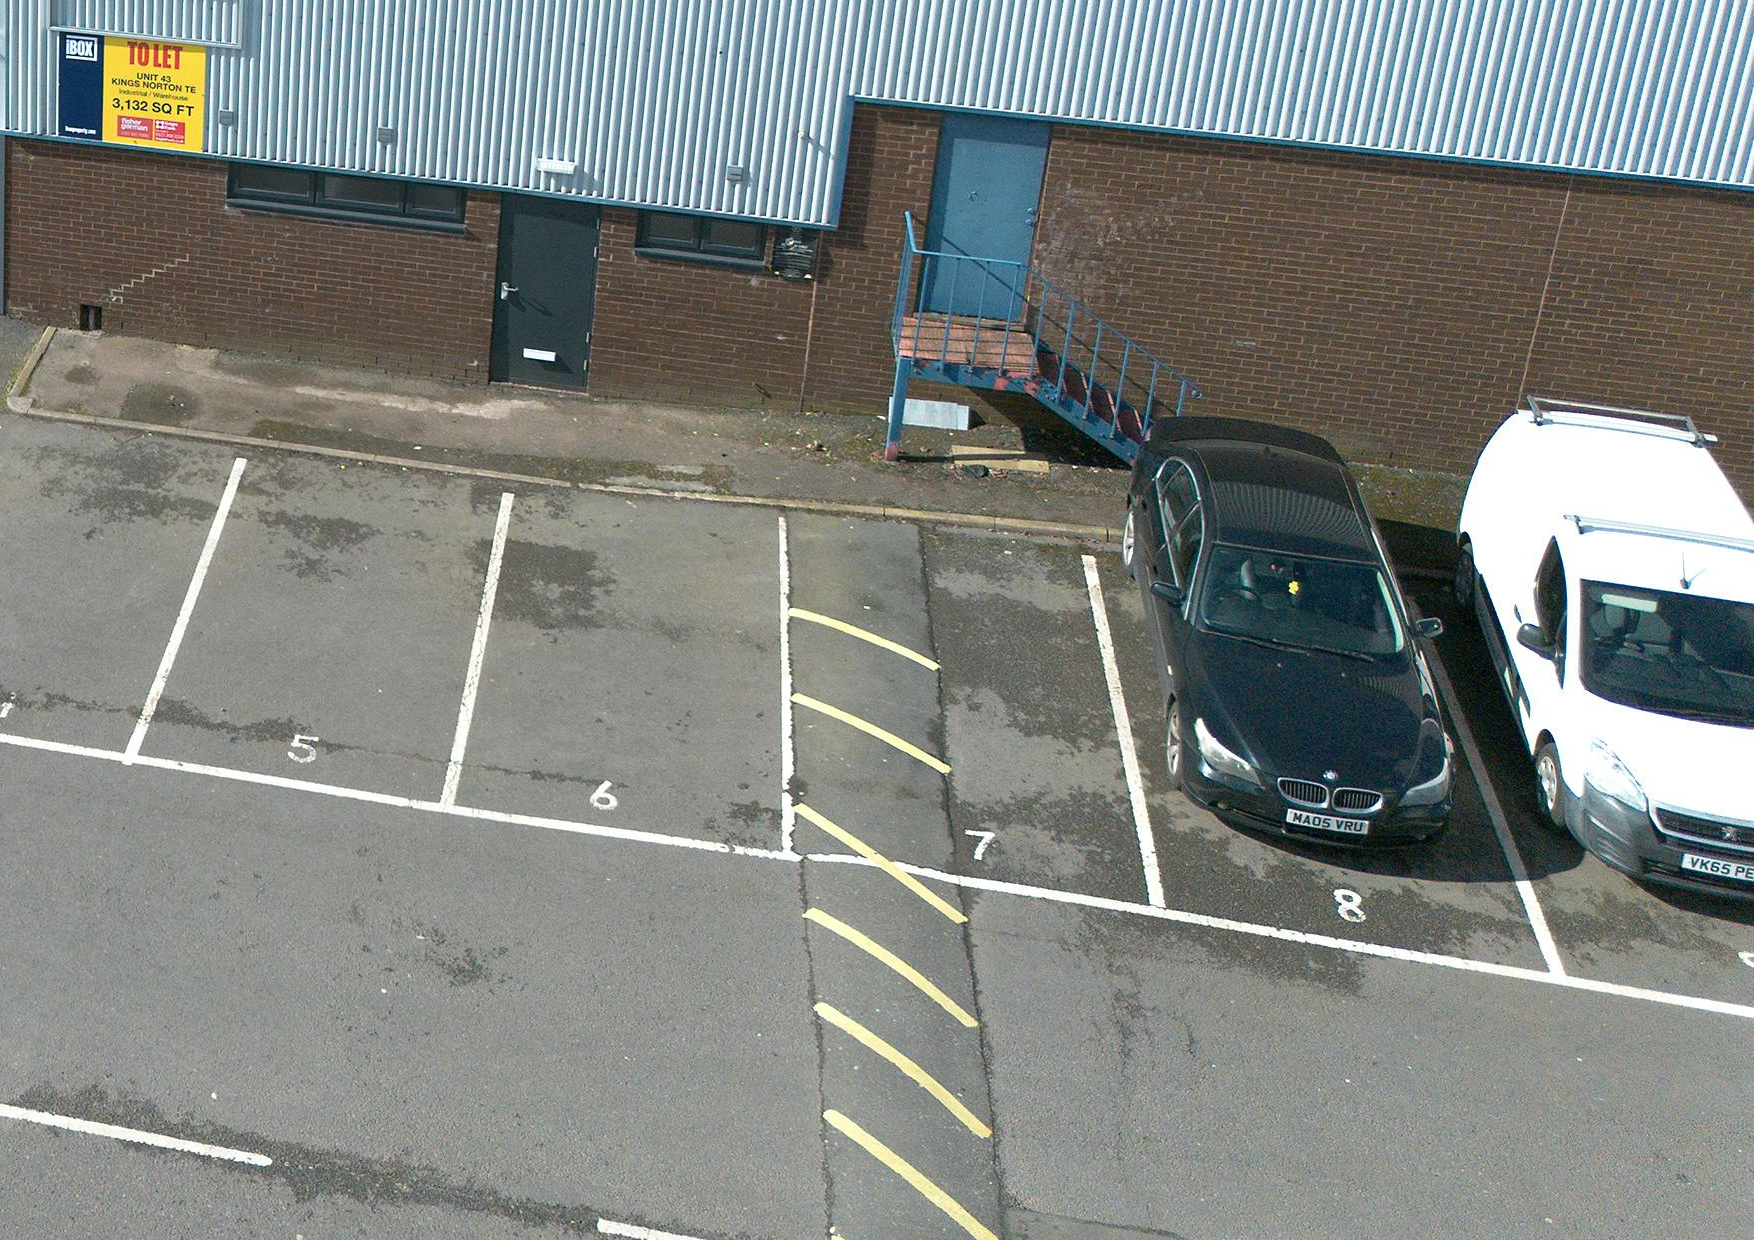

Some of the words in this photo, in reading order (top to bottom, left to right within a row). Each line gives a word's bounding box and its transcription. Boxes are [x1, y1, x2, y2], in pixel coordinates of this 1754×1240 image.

[65, 38, 94, 57] iBOX
[127, 40, 150, 66] TO
[153, 43, 183, 70] LET
[111, 77, 140, 88] KINGS
[142, 81, 182, 92] NORTON
[184, 85, 197, 94] TE
[136, 72, 159, 81] UNIT
[160, 75, 172, 83] 43
[118, 88, 148, 97] Industrial
[152, 92, 189, 102] Warehouse
[112, 97, 148, 112] 3,132
[152, 101, 173, 115] SQ
[176, 104, 195, 117] FT
[286, 734, 320, 764] 5
[588, 779, 620, 811] 6
[1292, 811, 1331, 829] MA05
[1335, 819, 1364, 833] VRU
[964, 828, 997, 861] 7
[1690, 856, 1732, 875] VK65
[1332, 887, 1367, 924] 8
